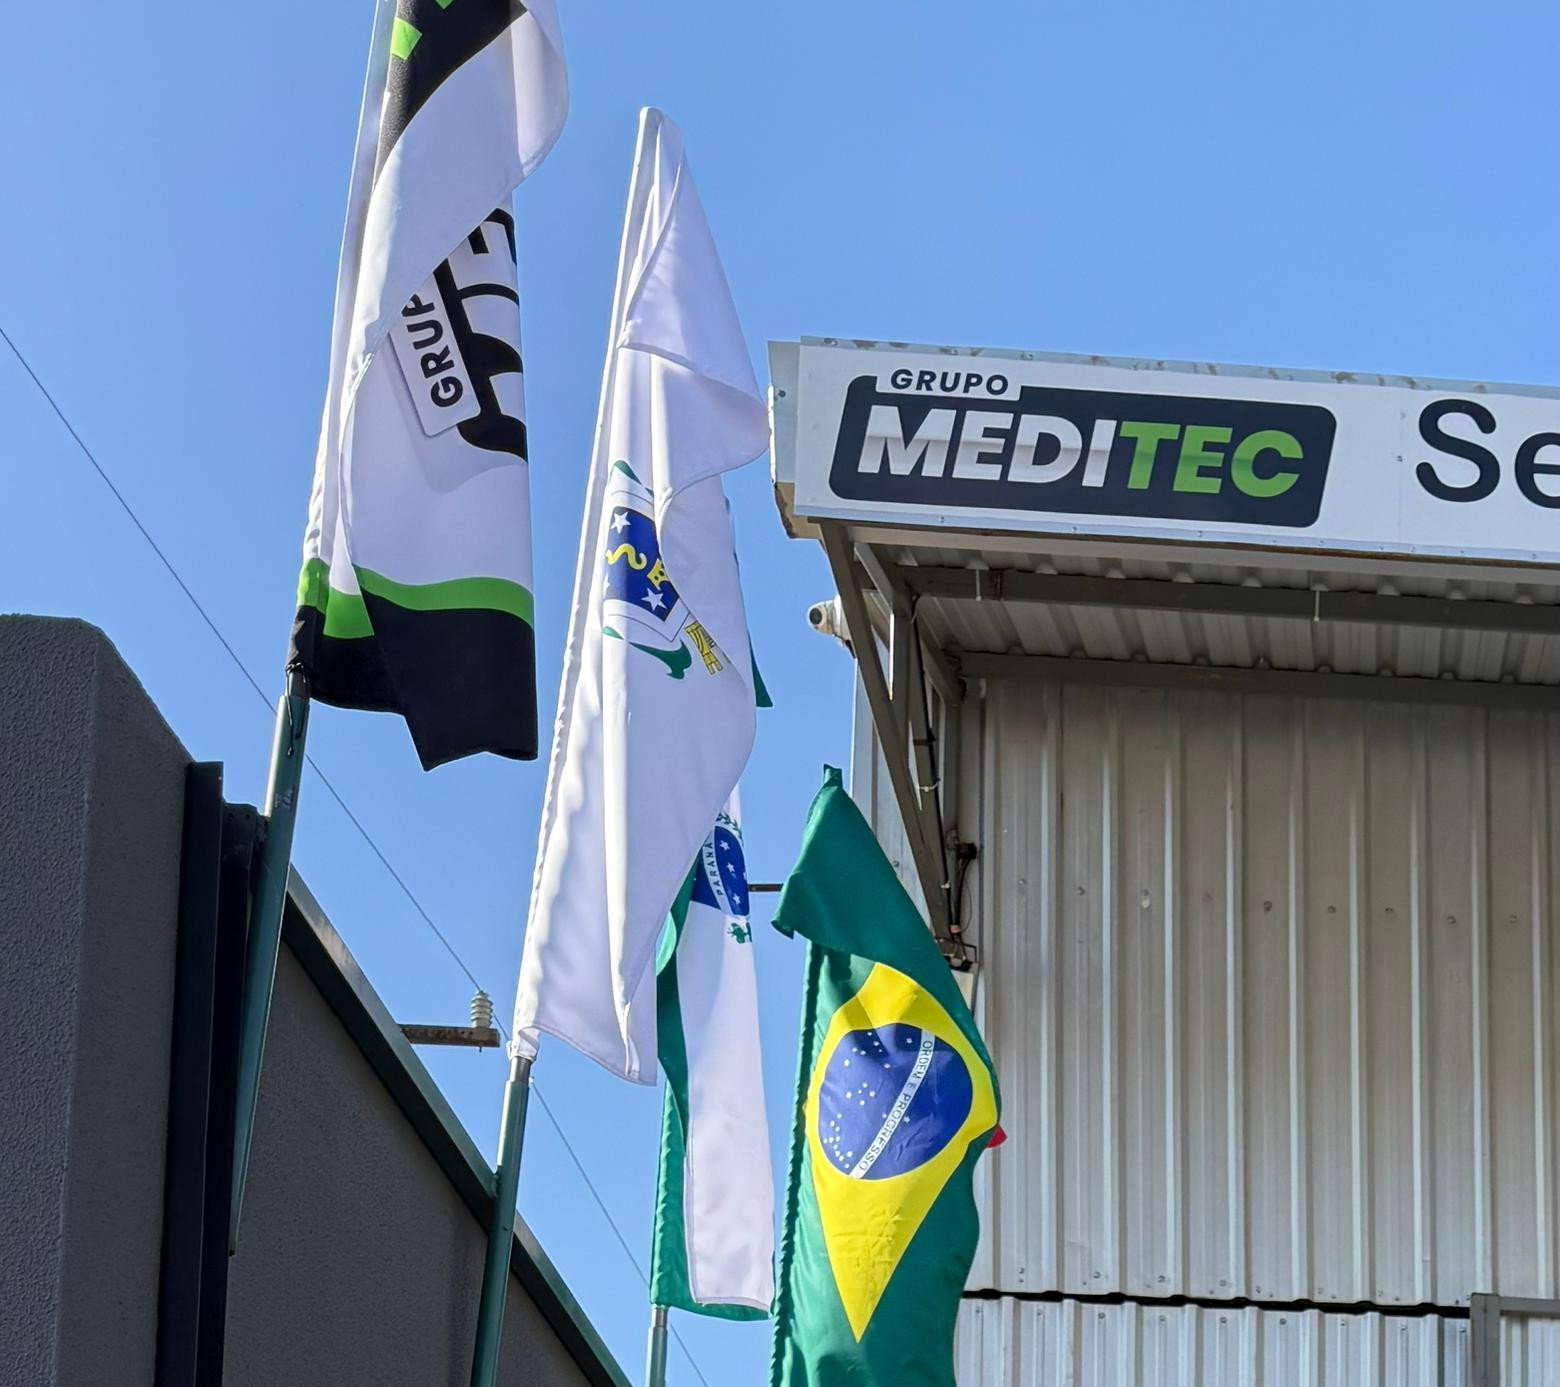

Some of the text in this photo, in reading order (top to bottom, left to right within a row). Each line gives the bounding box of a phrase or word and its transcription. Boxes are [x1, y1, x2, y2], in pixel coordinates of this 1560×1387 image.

[401, 293, 464, 408] GRUP
[890, 368, 1009, 396] GRUPO
[856, 405, 1304, 498] MEDITEC
[913, 1040, 933, 1080] ORDEM
[859, 1093, 911, 1171] PROGRESSO
